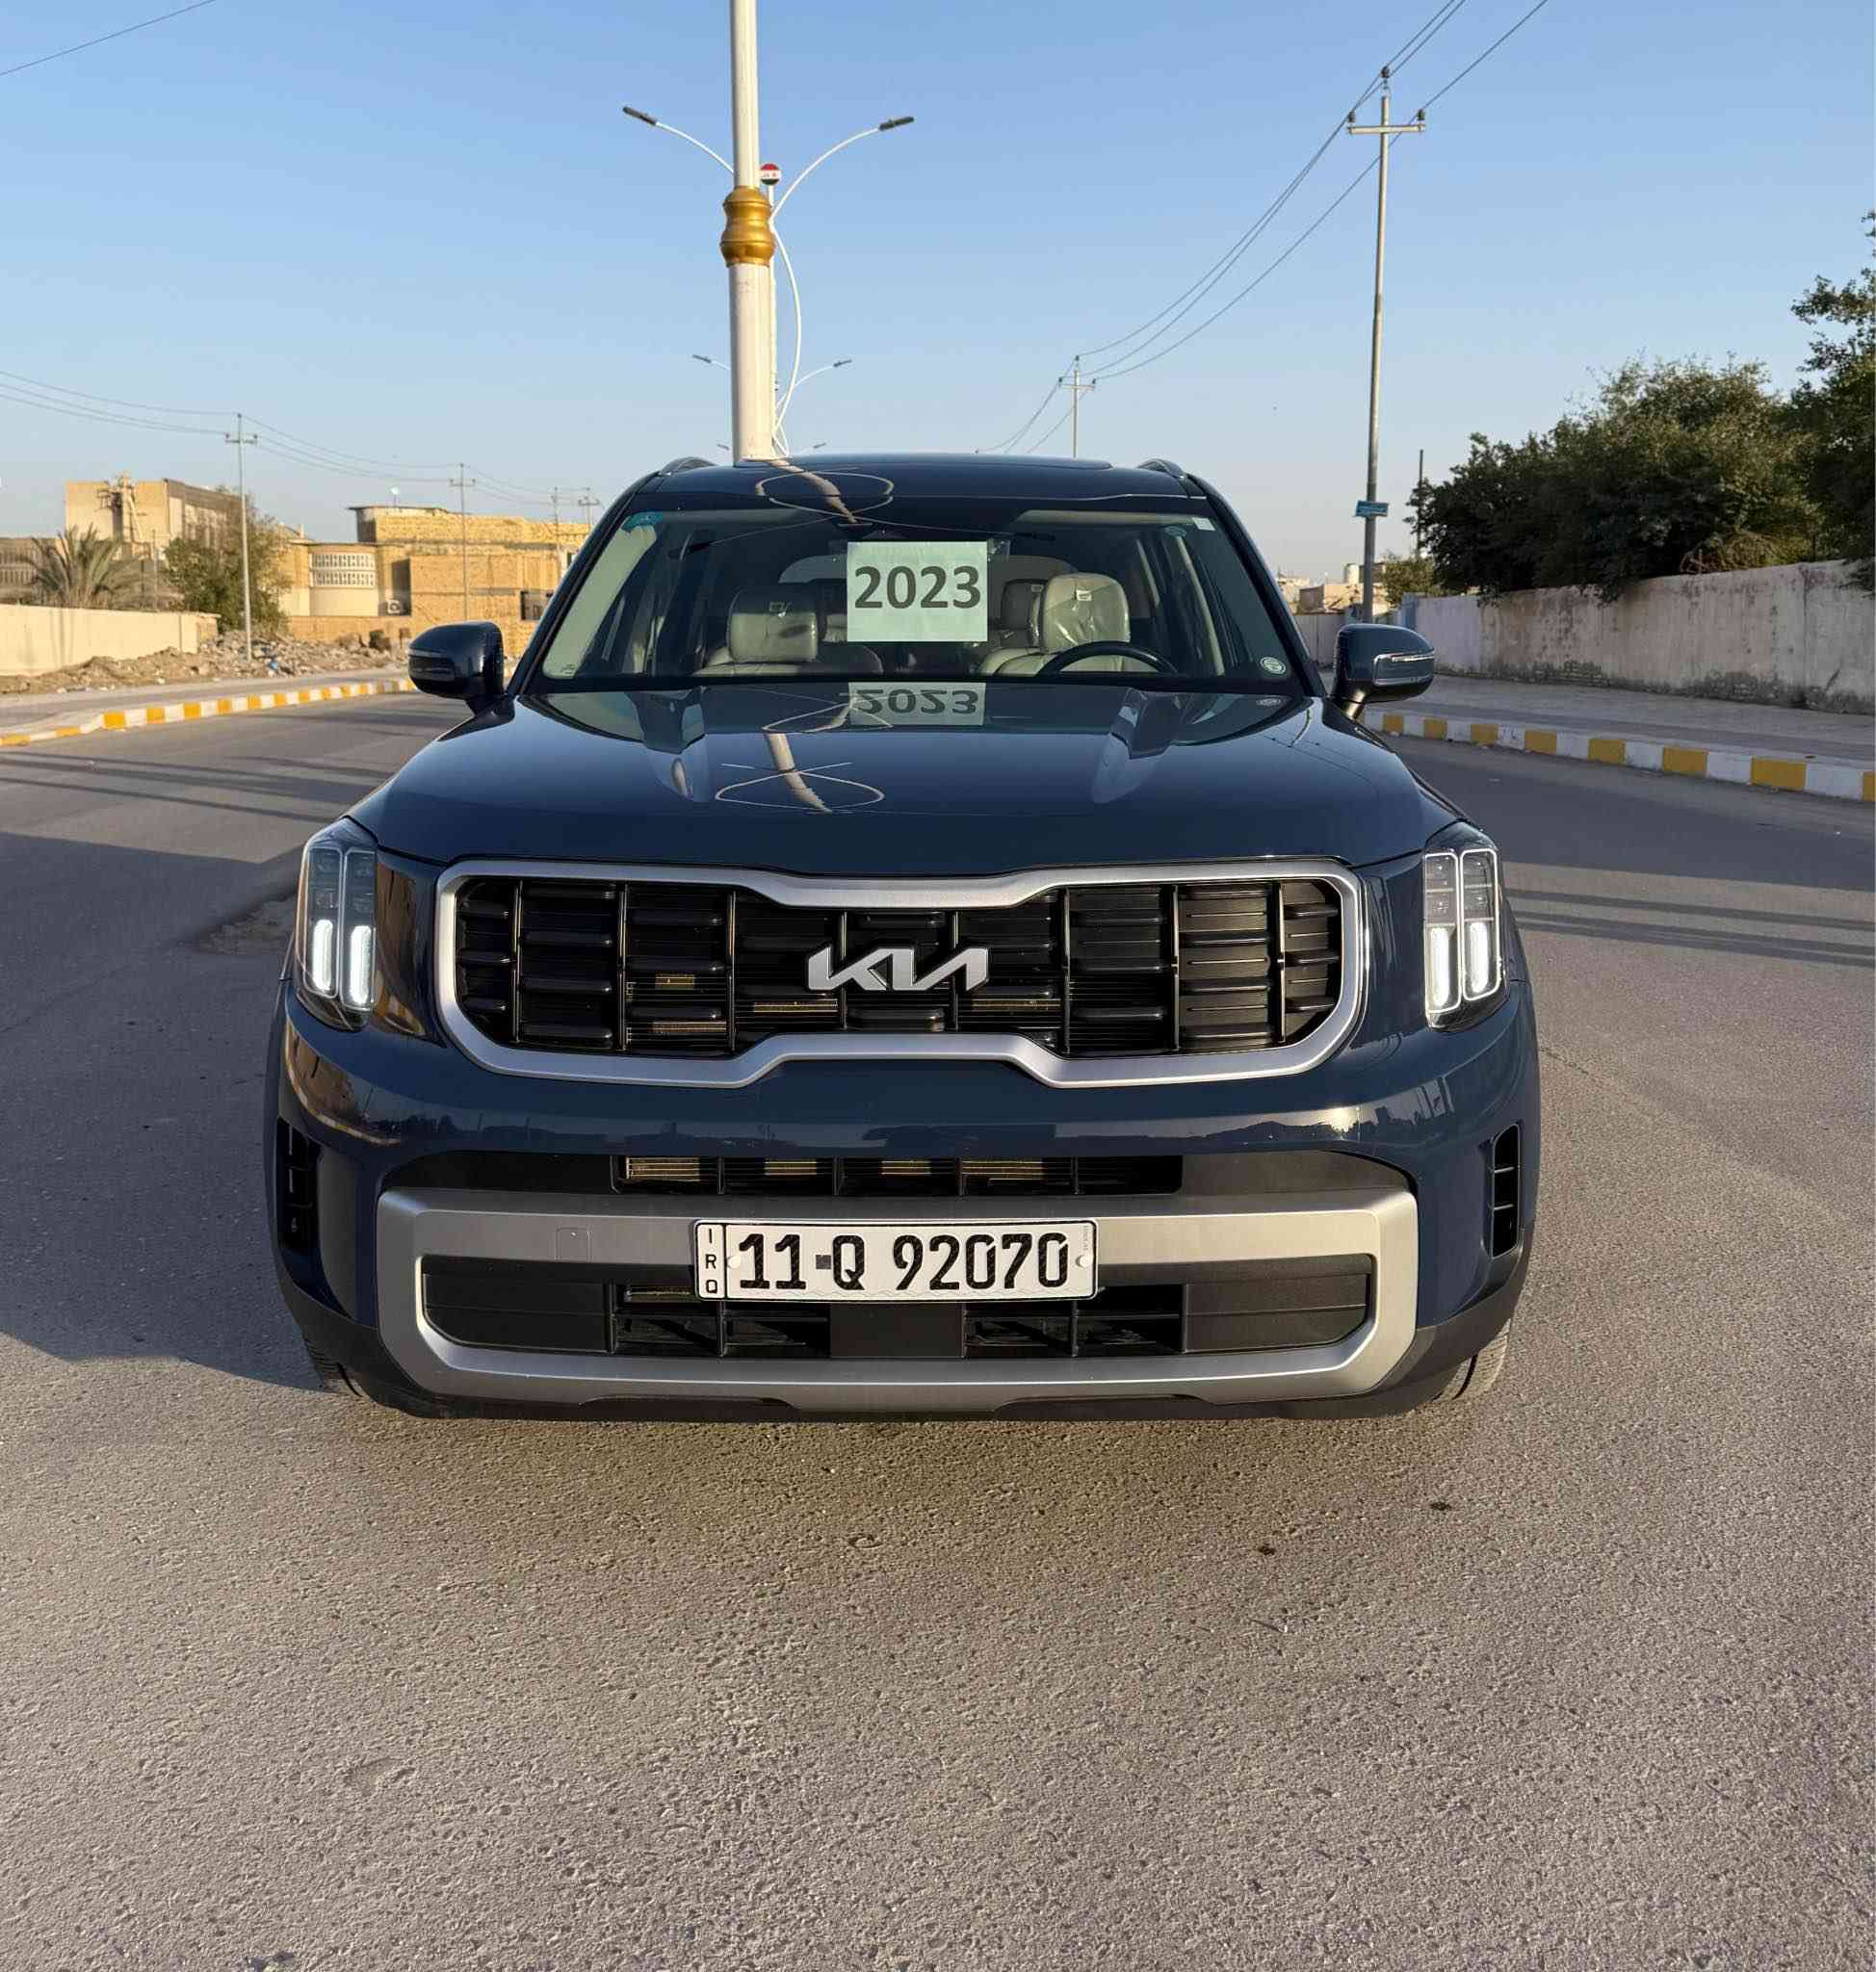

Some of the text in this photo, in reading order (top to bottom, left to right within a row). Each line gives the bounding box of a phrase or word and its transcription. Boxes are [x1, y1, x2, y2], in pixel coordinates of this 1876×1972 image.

[855, 565, 980, 609] 2023
[808, 945, 989, 991] KIA
[739, 1233, 807, 1289] 11
[833, 1234, 865, 1290] Q
[893, 1232, 1069, 1290] 92070
